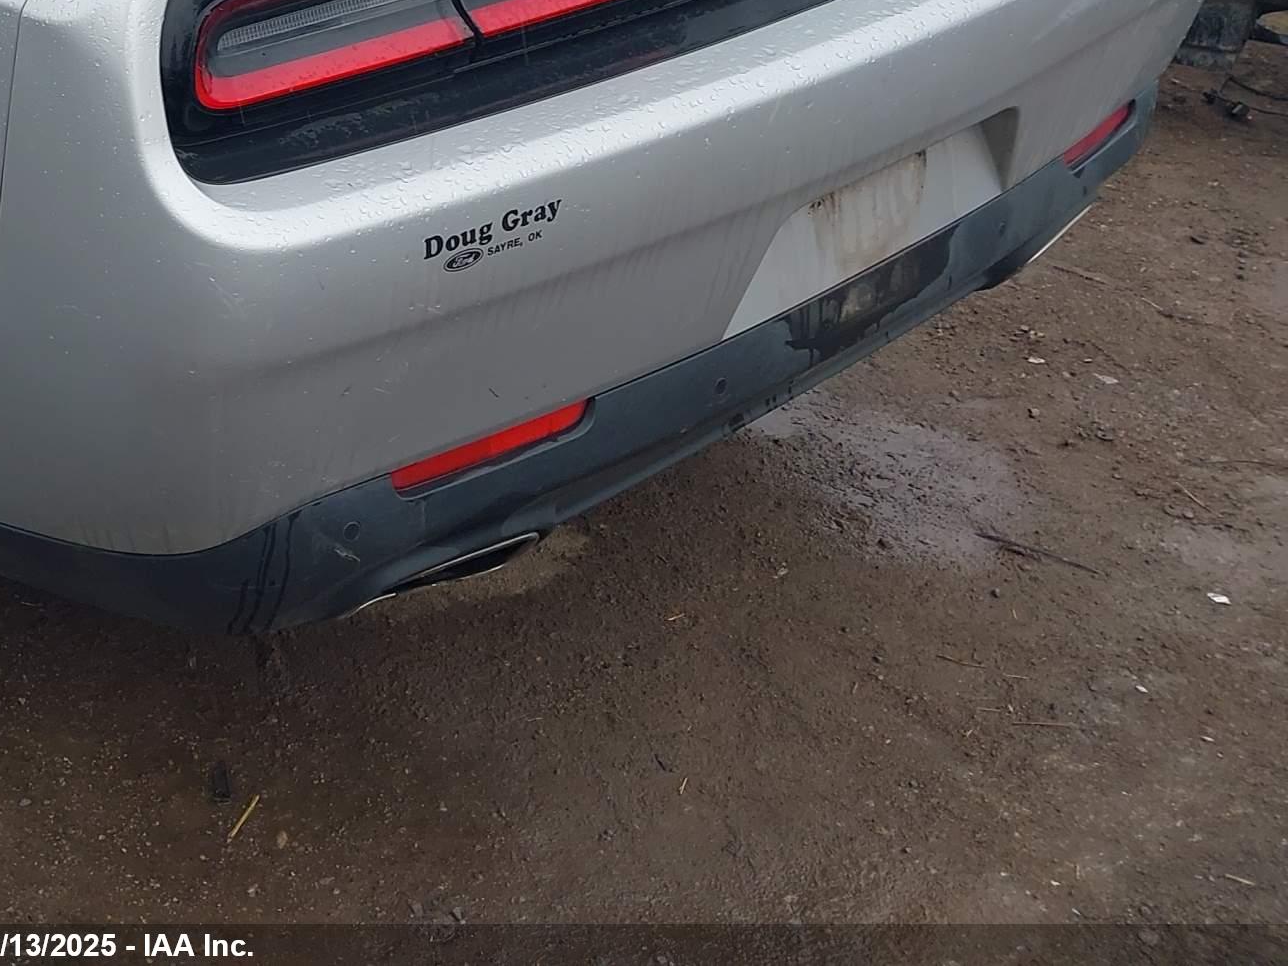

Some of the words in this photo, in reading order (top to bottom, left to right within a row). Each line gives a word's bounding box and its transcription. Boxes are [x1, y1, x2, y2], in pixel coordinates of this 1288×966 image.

[423, 221, 493, 260] Doug
[501, 198, 563, 232] Gray
[487, 237, 523, 257] SAYRE,
[527, 229, 543, 242] OK
